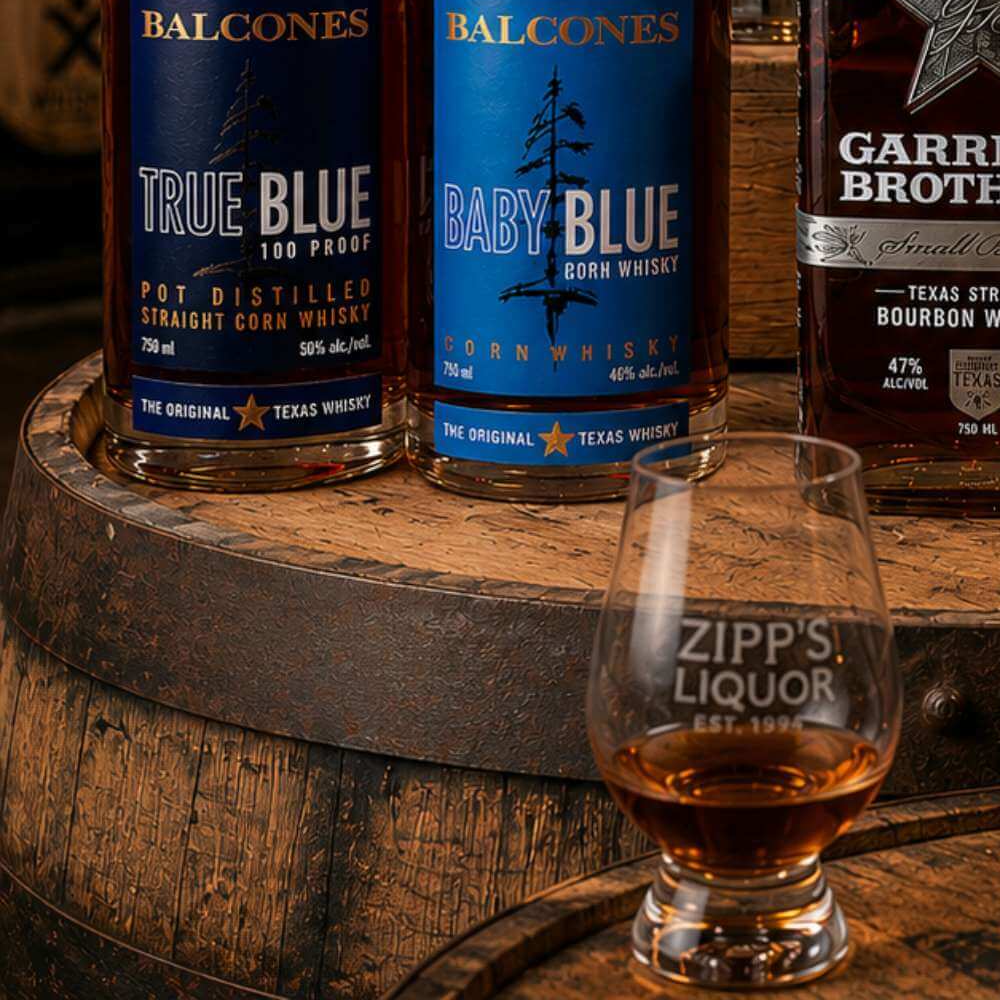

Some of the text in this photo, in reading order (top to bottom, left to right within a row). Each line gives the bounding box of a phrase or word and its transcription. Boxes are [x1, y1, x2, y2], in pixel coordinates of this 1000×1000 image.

[141, 8, 369, 42] BALCONES
[446, 11, 679, 46] BALCONES
[139, 165, 371, 236] TRUE BLUE
[444, 183, 679, 256] BABY BLUE
[261, 233, 371, 261] 100 PROOF
[619, 255, 679, 278] WHISKY
[141, 278, 371, 307] POT DISTILLED
[909, 285, 959, 302] TEXAS
[141, 303, 371, 332] STRAIGHT CORN WHISKY
[877, 306, 975, 328] BOURBON
[299, 340, 325, 356] 50%
[444, 335, 679, 361] CORN WHISKY
[888, 357, 923, 376] 47%
[141, 394, 371, 420] THE ORIGINAL TEXAS WHISKY
[443, 421, 679, 446] THE ORIGINAL TEXAS WHISKY
[958, 422, 978, 435] 750
[677, 617, 833, 665] ZIPP'S
[673, 665, 836, 712] LIQUOR
[693, 713, 742, 734] EST.
